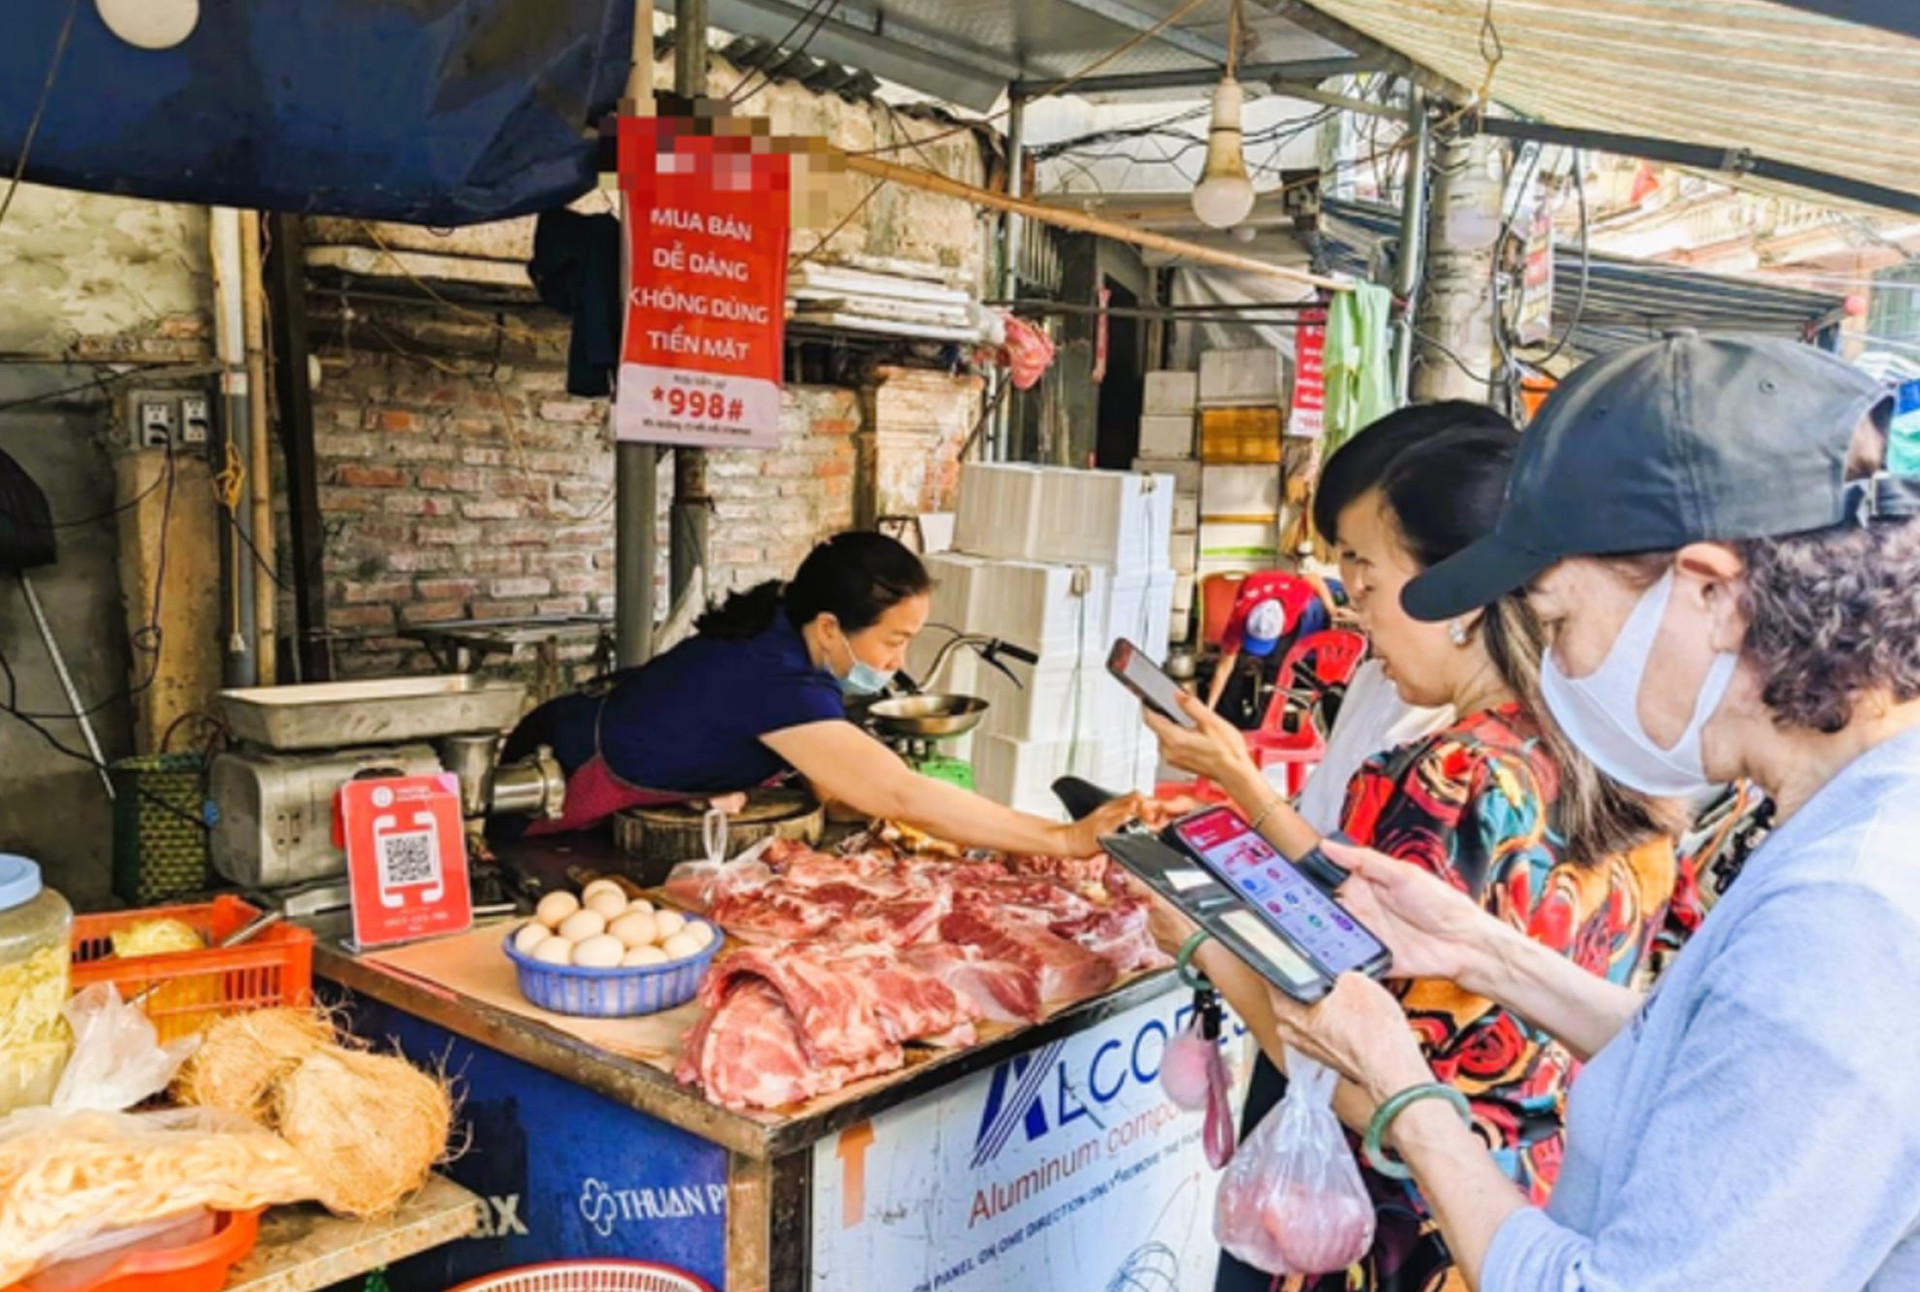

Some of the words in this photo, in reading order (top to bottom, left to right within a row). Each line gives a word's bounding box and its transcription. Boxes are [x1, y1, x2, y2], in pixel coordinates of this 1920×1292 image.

[650, 207, 704, 233] MUA
[707, 212, 753, 242] BÁN
[628, 285, 708, 315] KHÔNG
[711, 296, 769, 324] DÙNG
[705, 1183, 728, 1216] P
[968, 1137, 1101, 1229] Aluminum
